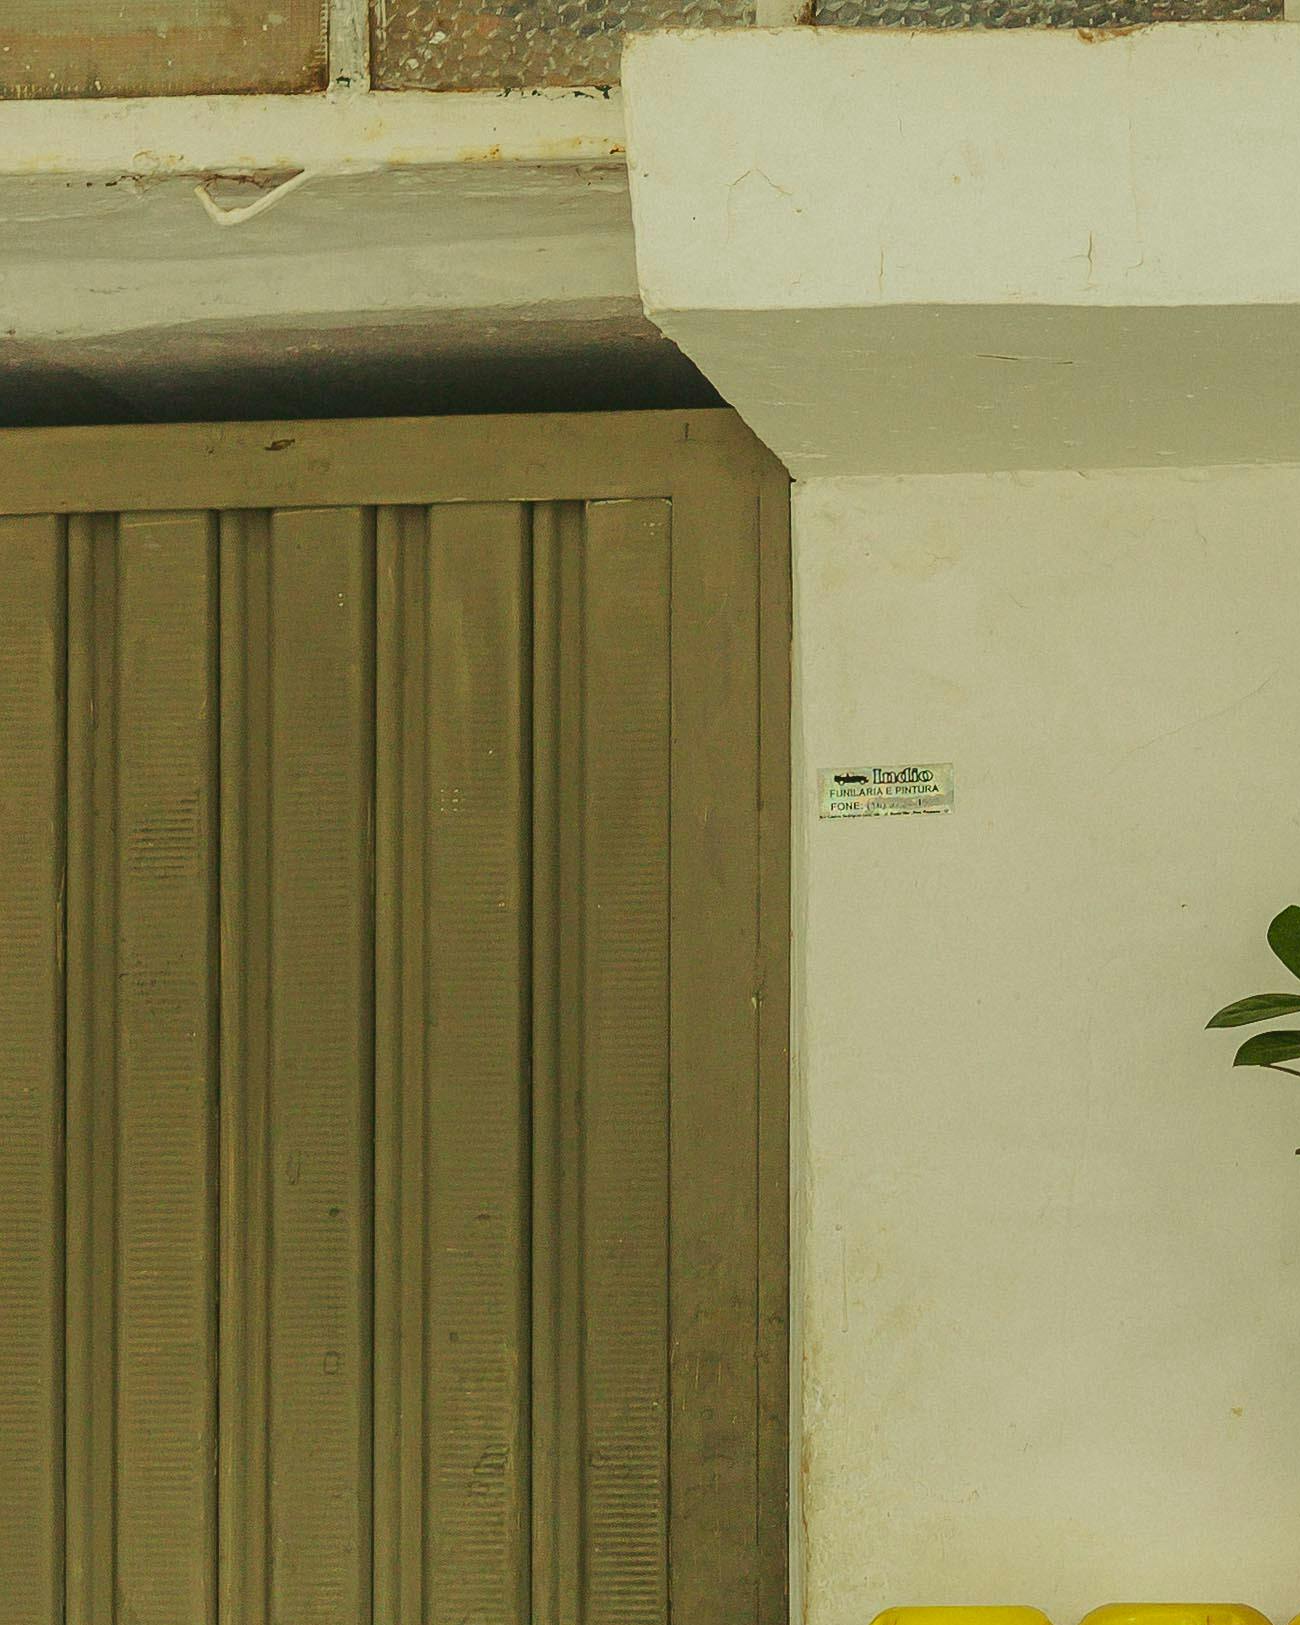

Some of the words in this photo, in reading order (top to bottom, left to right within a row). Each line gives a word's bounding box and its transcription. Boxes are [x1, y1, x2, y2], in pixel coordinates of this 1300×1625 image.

[872, 767, 934, 785] Indio
[829, 789, 883, 798] FUNILARIA
[885, 787, 893, 795] E
[895, 784, 939, 795] PINTURA
[830, 802, 863, 811] FONE:
